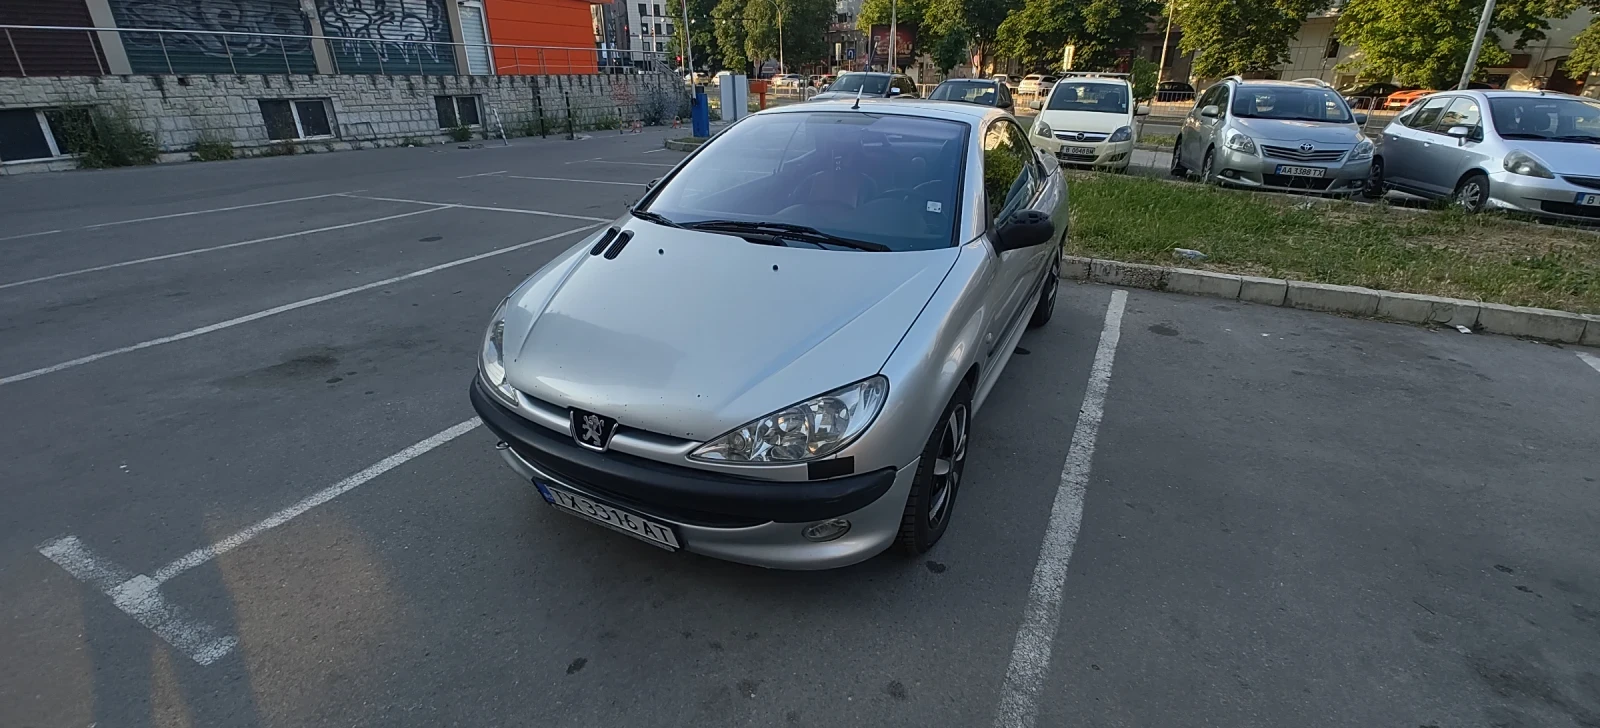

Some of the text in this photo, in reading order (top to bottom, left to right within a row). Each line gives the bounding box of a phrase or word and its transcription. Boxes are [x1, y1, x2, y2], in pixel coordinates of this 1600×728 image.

[1281, 166, 1292, 175] AA
[1312, 169, 1324, 177] TX
[1587, 195, 1595, 205] B
[642, 520, 669, 542] AT
